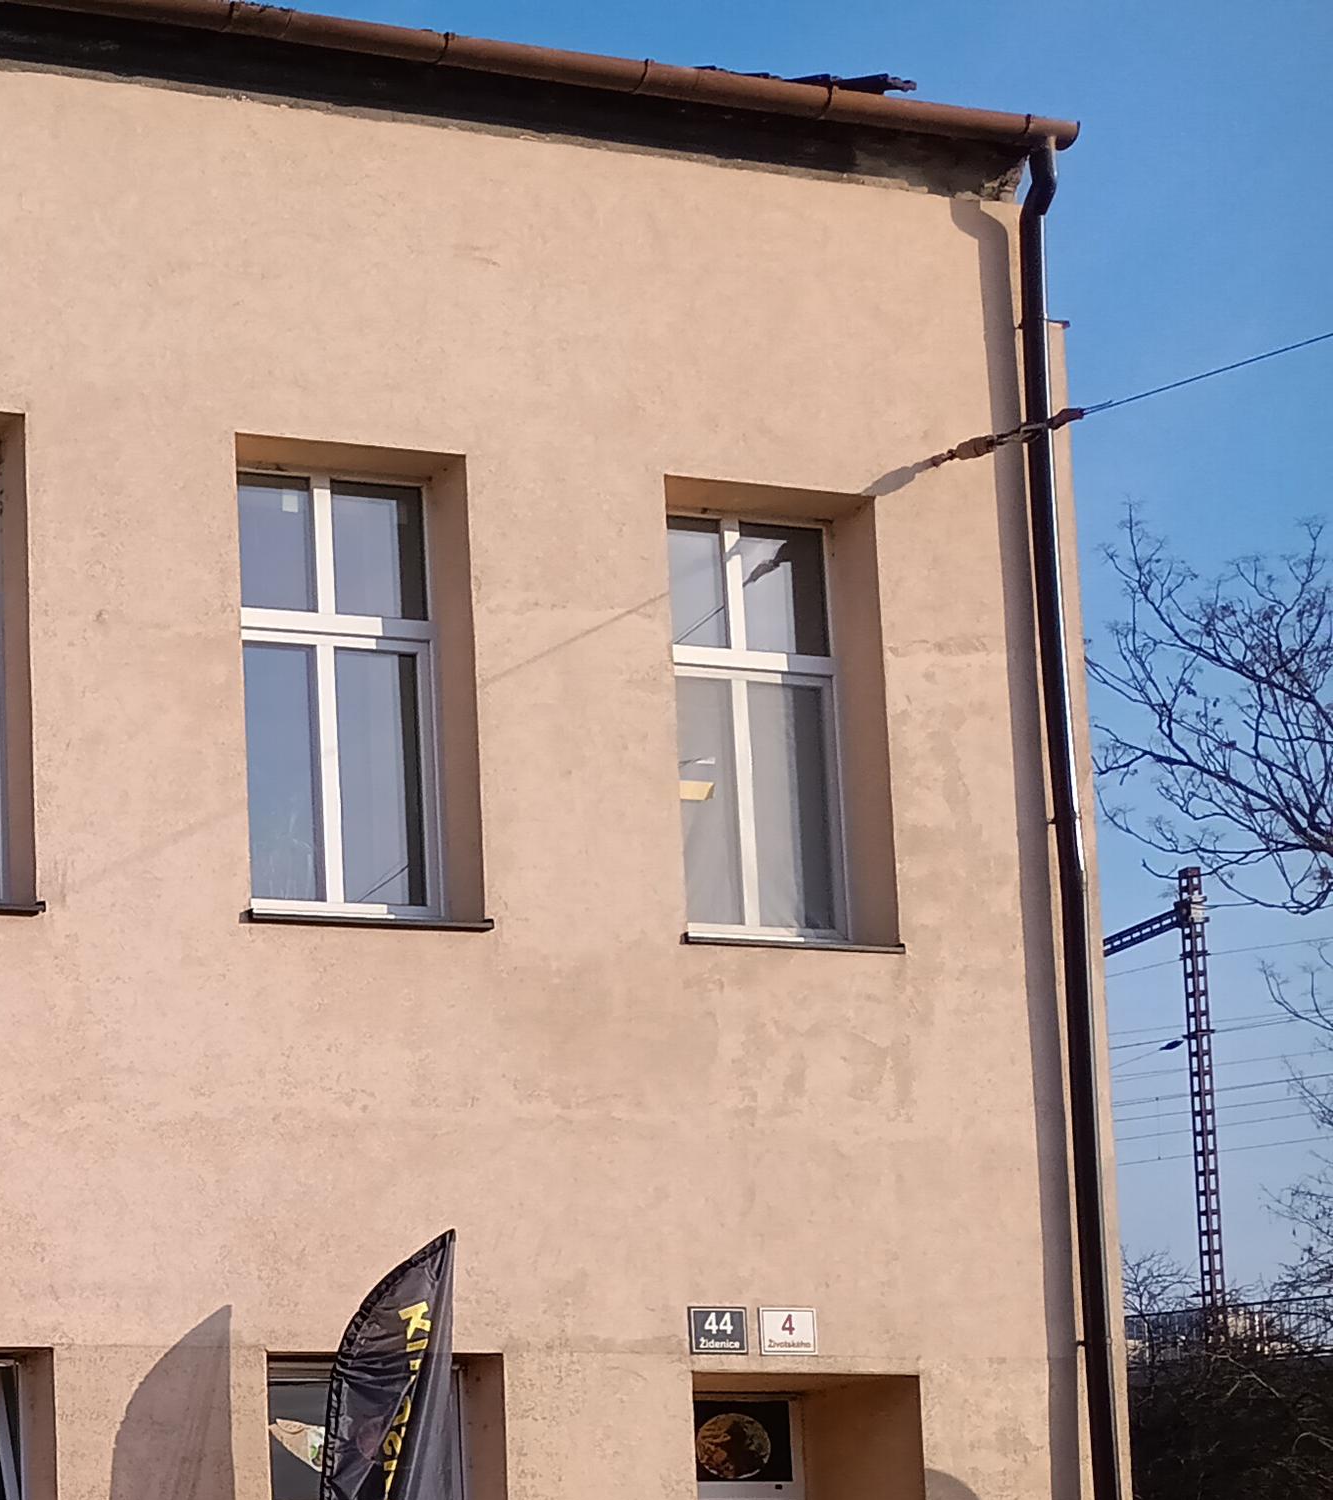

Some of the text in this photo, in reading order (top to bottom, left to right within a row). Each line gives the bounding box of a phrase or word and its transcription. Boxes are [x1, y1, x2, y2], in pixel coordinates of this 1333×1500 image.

[704, 1311, 734, 1335] 44
[780, 1313, 796, 1336] 4
[699, 1336, 741, 1349] Židenice
